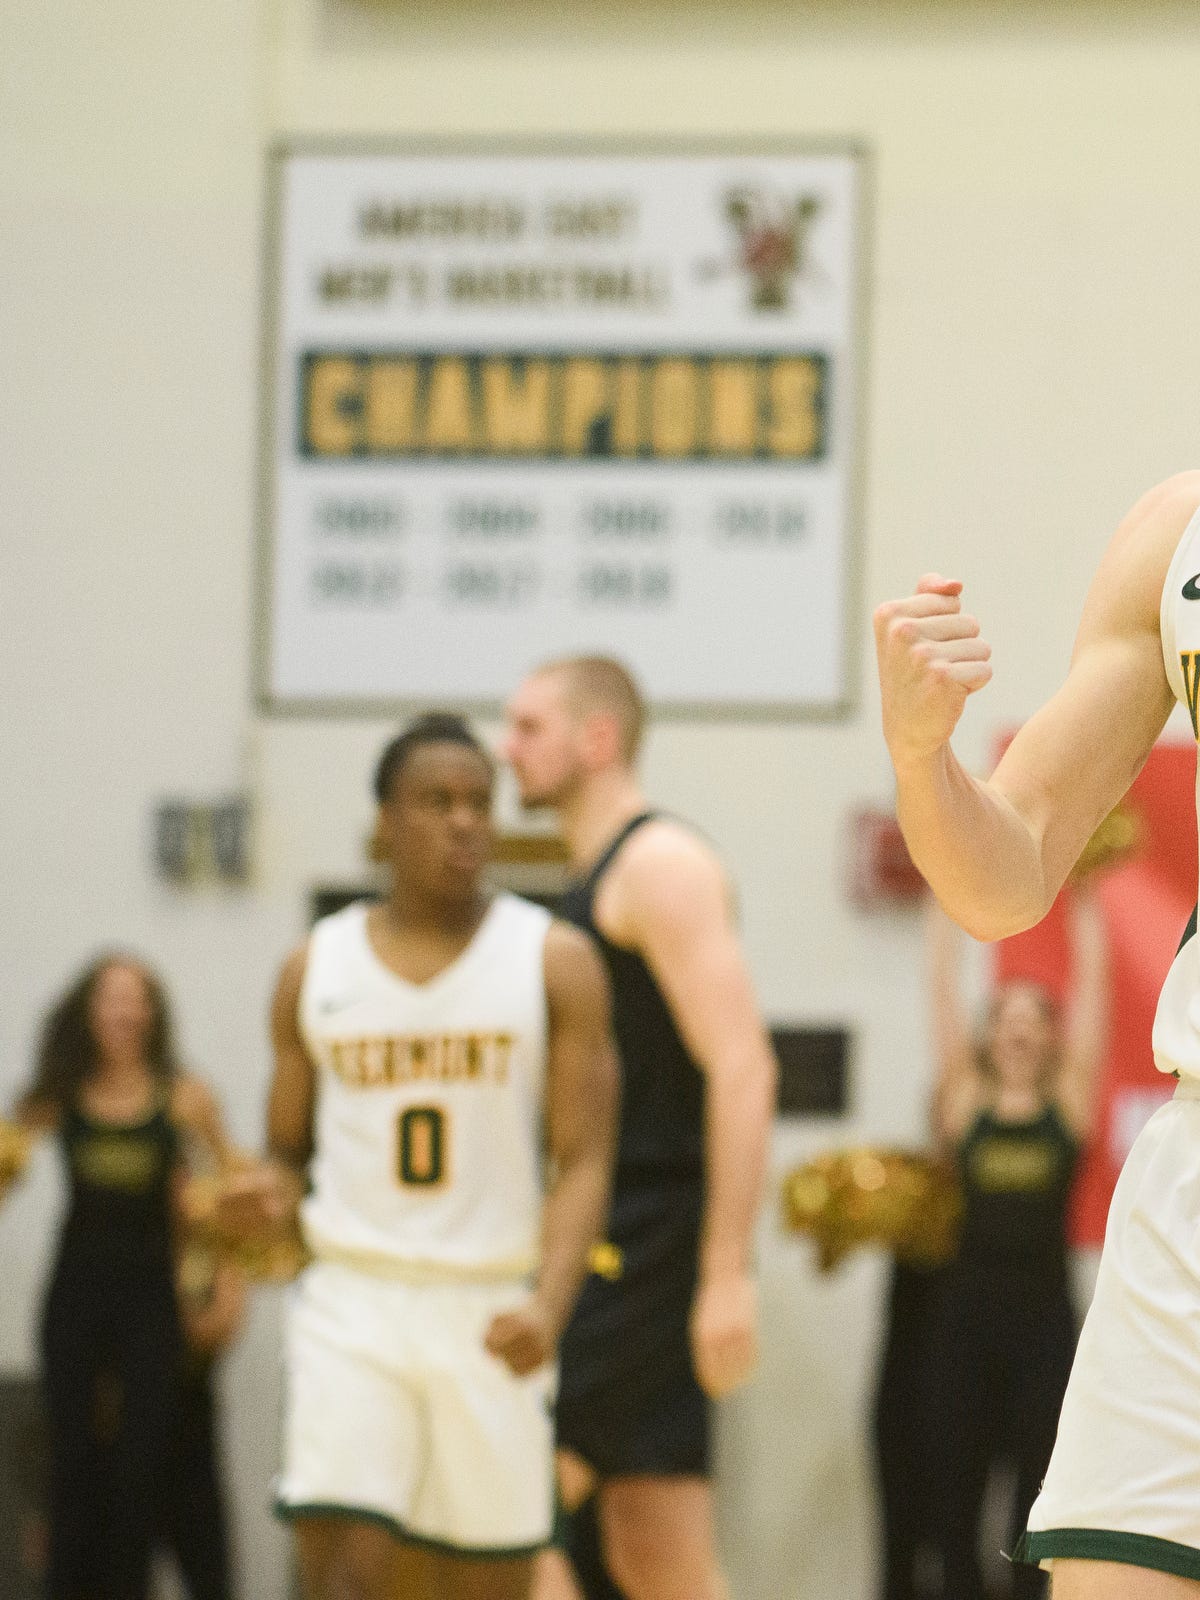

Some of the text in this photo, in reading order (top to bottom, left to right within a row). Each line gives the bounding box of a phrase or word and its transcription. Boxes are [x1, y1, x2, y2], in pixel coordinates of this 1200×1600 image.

[306, 354, 822, 460] CHAMPIONS
[324, 1030, 514, 1090] VERMONT
[397, 1104, 447, 1190] 0
